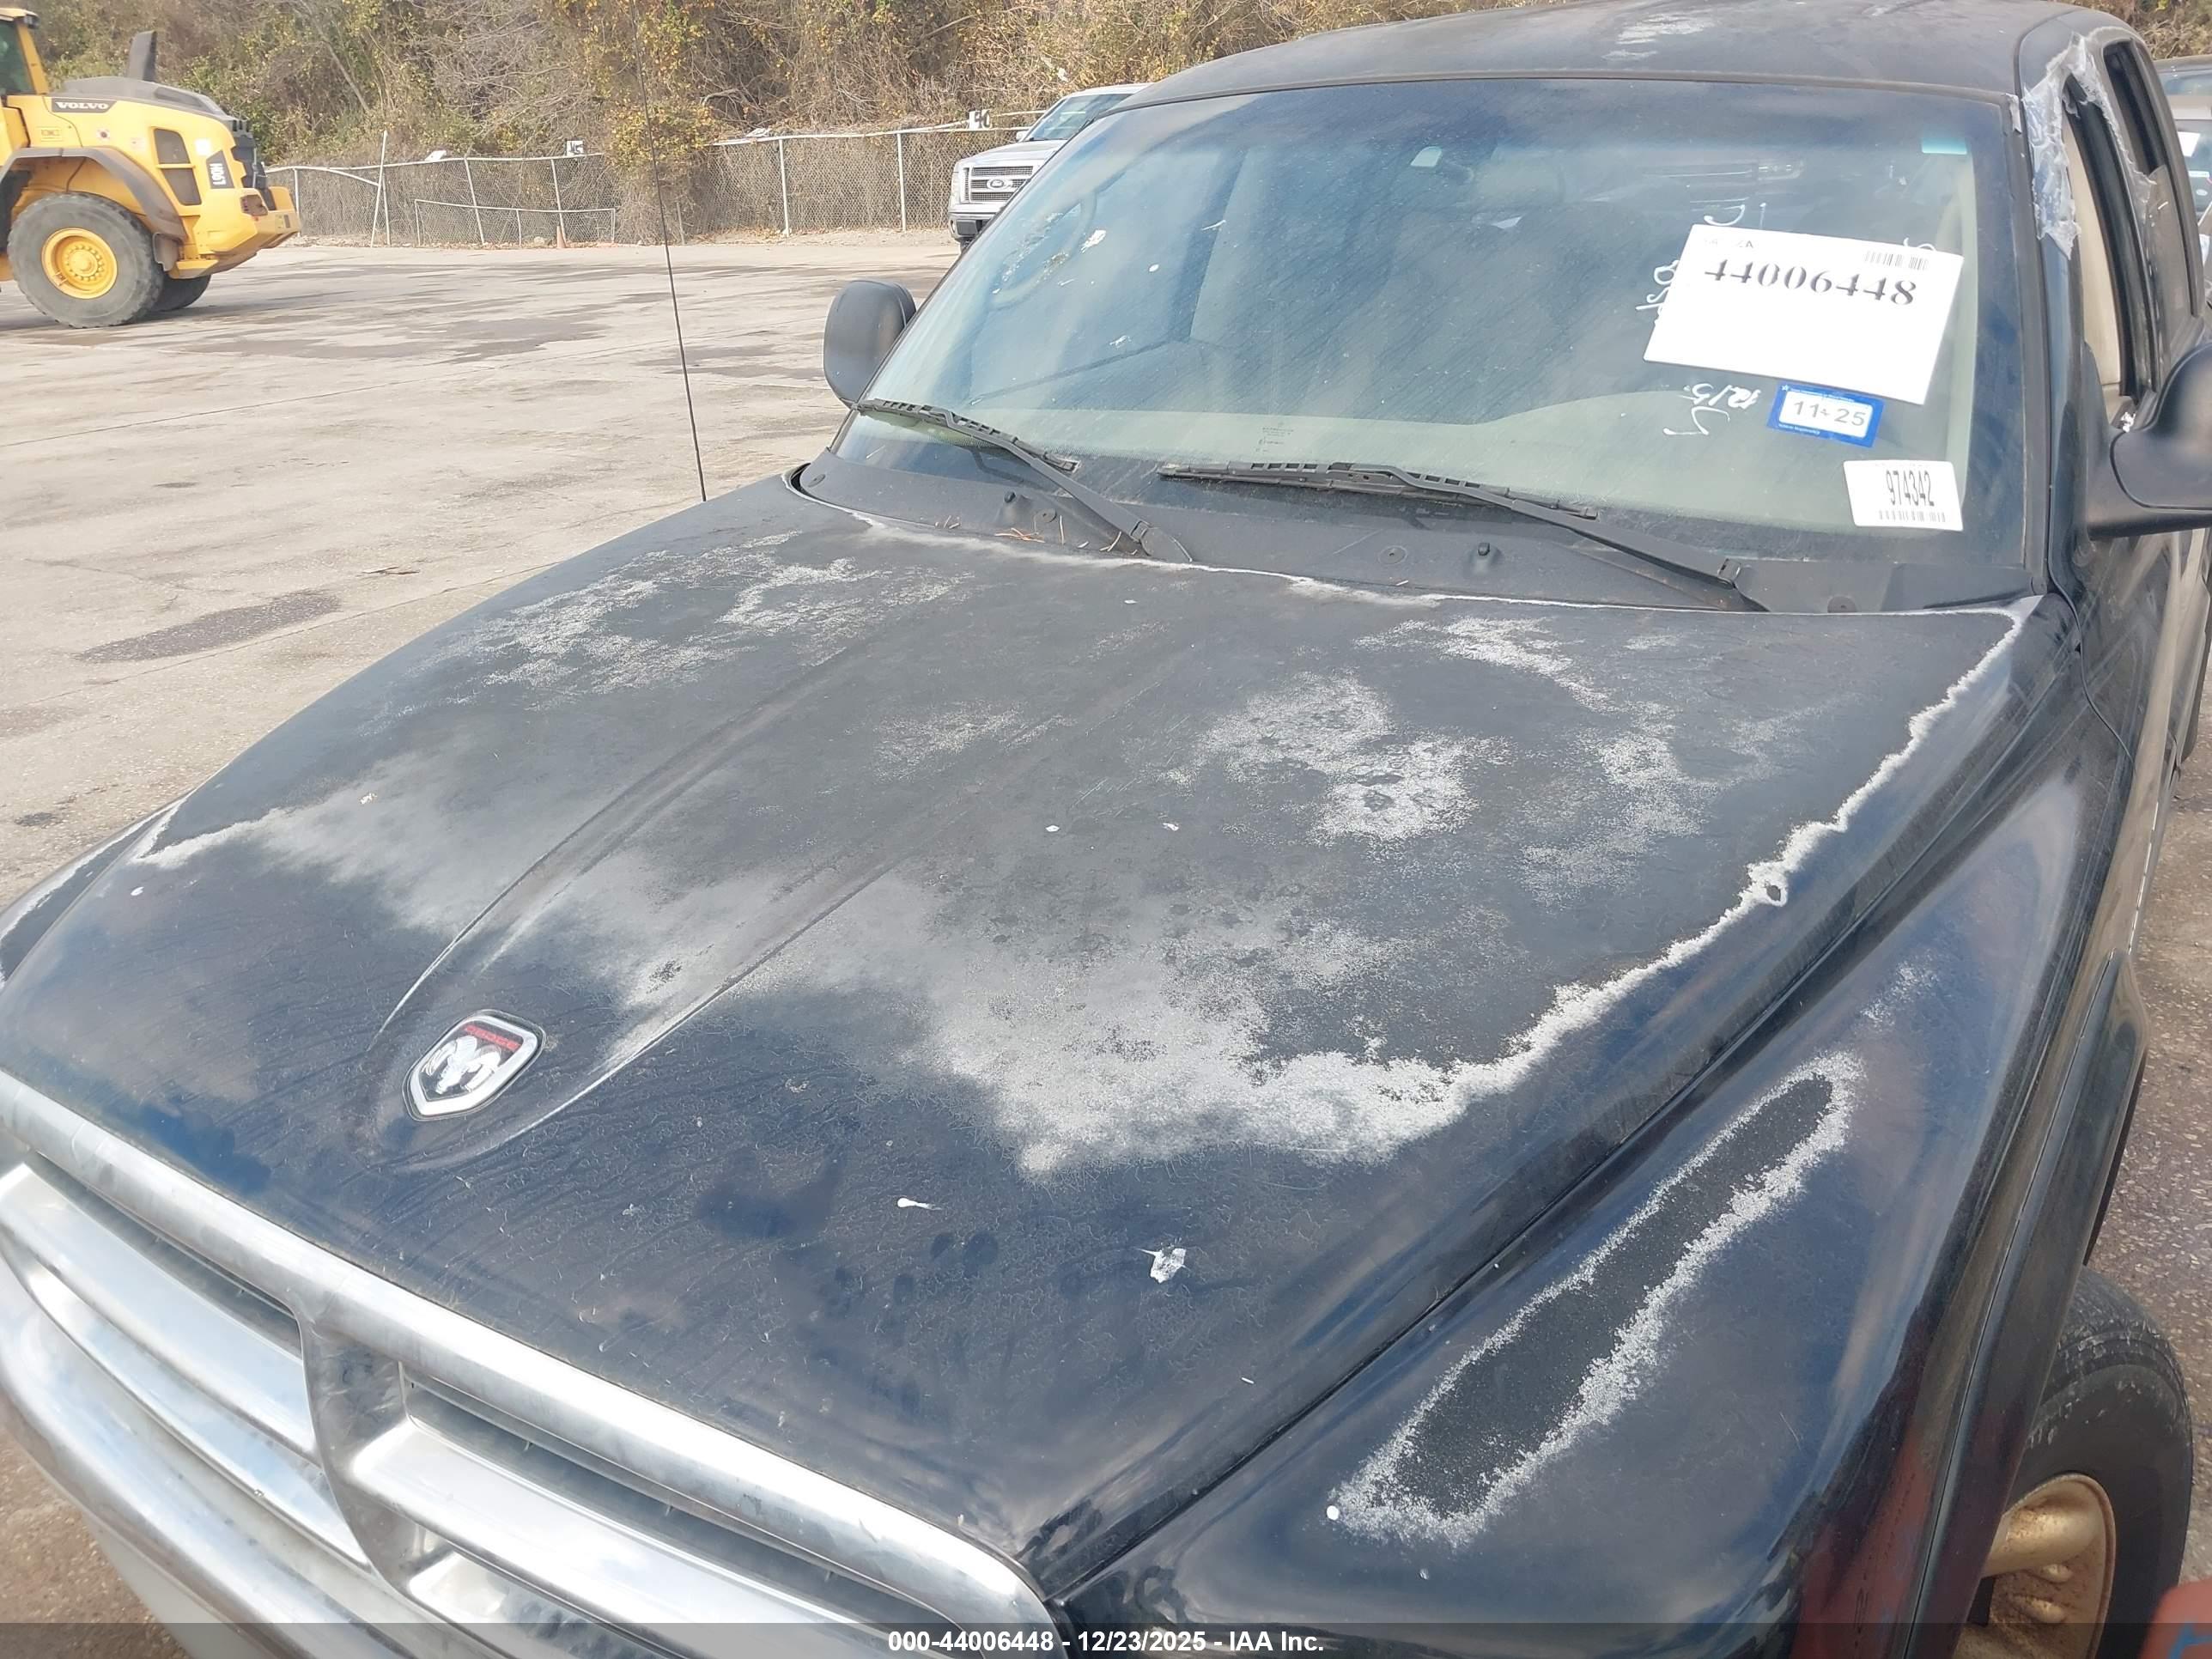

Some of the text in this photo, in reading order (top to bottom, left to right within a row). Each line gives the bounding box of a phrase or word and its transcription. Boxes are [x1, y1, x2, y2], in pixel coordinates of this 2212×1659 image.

[55, 101, 109, 110] VOLVO
[1704, 258, 1917, 306] 44006448
[1886, 470, 1935, 507] 974342
